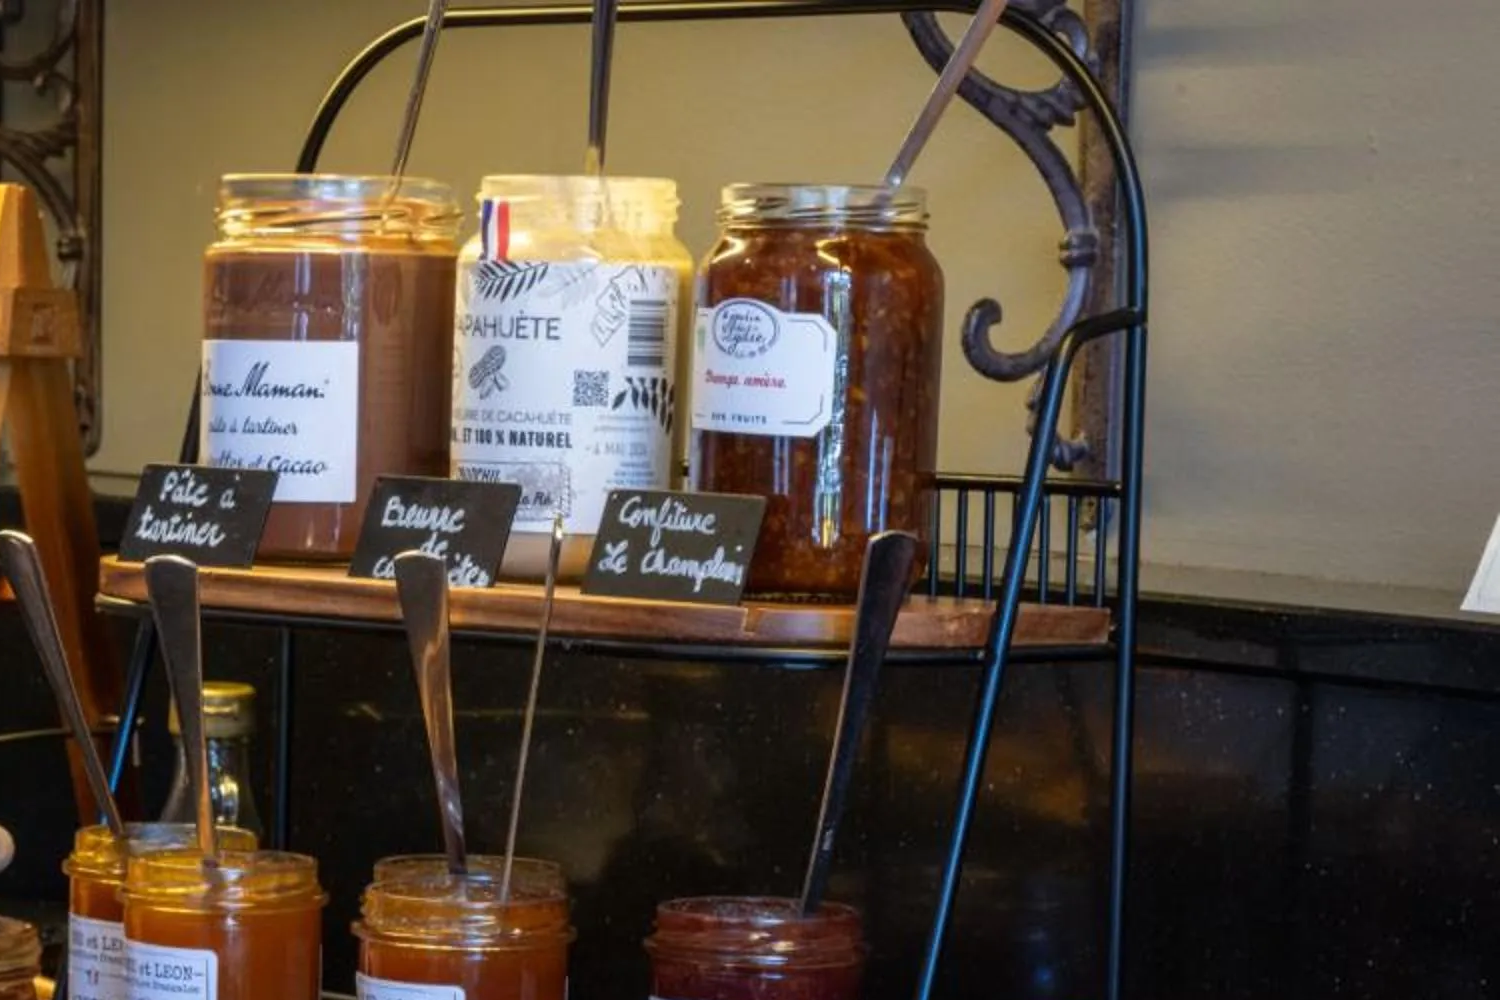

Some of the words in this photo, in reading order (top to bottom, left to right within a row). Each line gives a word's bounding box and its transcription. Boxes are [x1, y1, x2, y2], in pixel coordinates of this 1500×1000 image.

[241, 415, 298, 435] tartiner
[509, 429, 573, 449] NATUREL
[266, 455, 328, 476] Cacao
[159, 468, 208, 508] Pâte
[134, 504, 227, 547] tartiner
[380, 496, 466, 533] Beurre
[618, 495, 717, 548] Confiture
